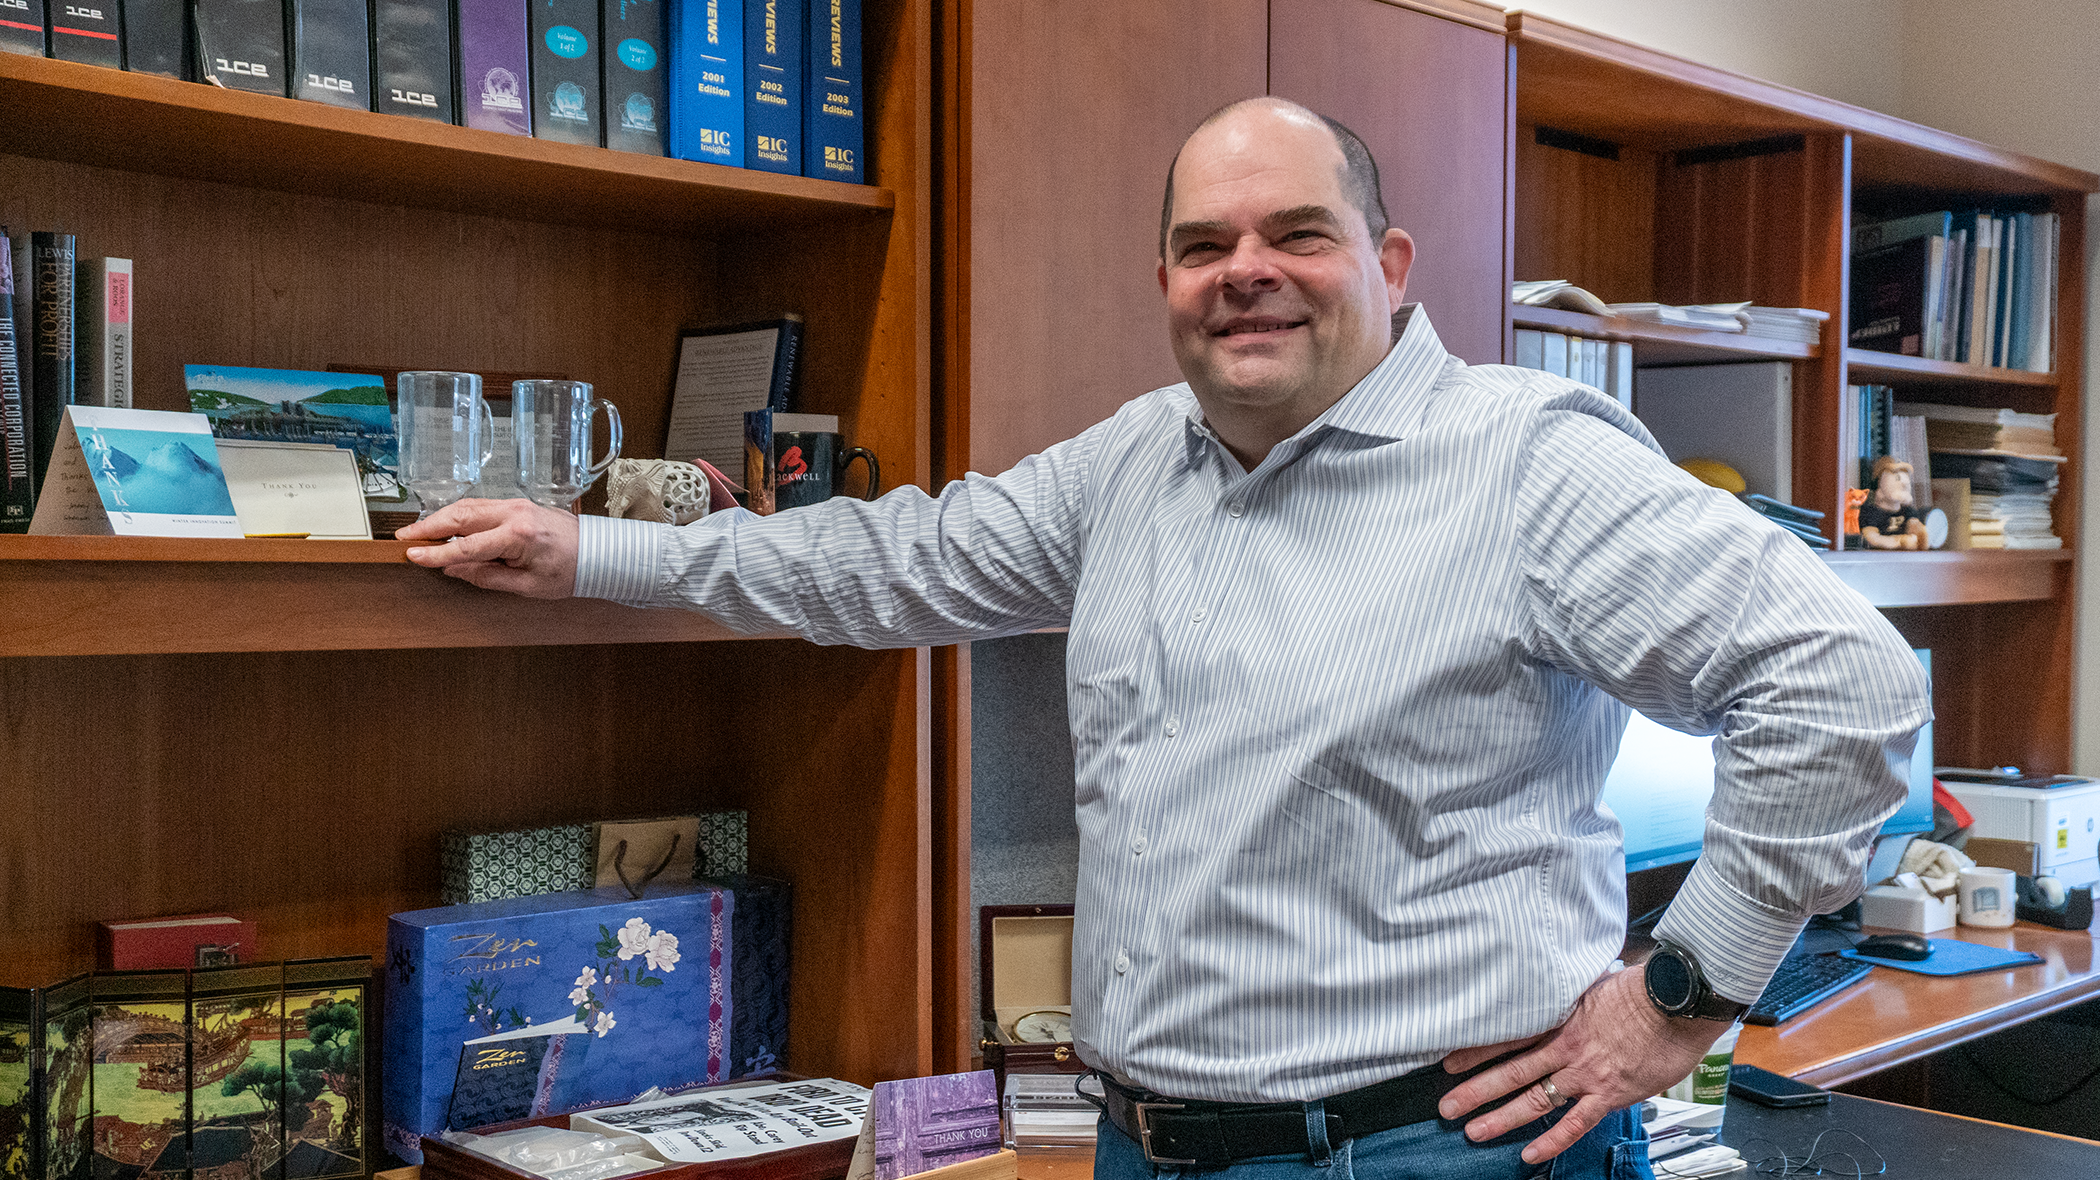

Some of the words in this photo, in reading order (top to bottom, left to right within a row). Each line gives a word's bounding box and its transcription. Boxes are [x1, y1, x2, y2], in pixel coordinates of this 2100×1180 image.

[707, 0, 719, 45] IEWS
[765, 0, 776, 54] VIEWS
[702, 71, 724, 84] 2001
[698, 83, 730, 97] Edition
[760, 80, 783, 92] 2002
[756, 92, 788, 106] Edition
[826, 92, 850, 104] 2003
[822, 104, 854, 116] Edition
[713, 130, 730, 146] IC
[770, 137, 788, 153] IC
[700, 143, 731, 156] Insights
[757, 150, 788, 162] Insights
[837, 148, 854, 164] IC
[824, 160, 854, 172] Insights
[39, 247, 74, 260] LEWIS
[41, 262, 58, 295] FOR
[60, 262, 72, 360] PARTNERSHIPS
[40, 301, 58, 360] PROFIT
[0, 341, 19, 400] CONNECTED
[784, 335, 798, 392] RENEWABLE
[4, 404, 27, 478] CORPORATION
[86, 412, 133, 525] THANKS
[447, 931, 538, 963] Zen
[443, 956, 540, 976] GARDEN
[472, 1058, 526, 1070] GARDEN
[476, 1048, 526, 1064] Zen
[821, 1095, 864, 1105] TO
[844, 1104, 869, 1120] CI
[788, 1105, 853, 1128] DEAD
[743, 1130, 768, 1146] Stand
[934, 1130, 966, 1144] THANK
[968, 1127, 988, 1140] YOU
